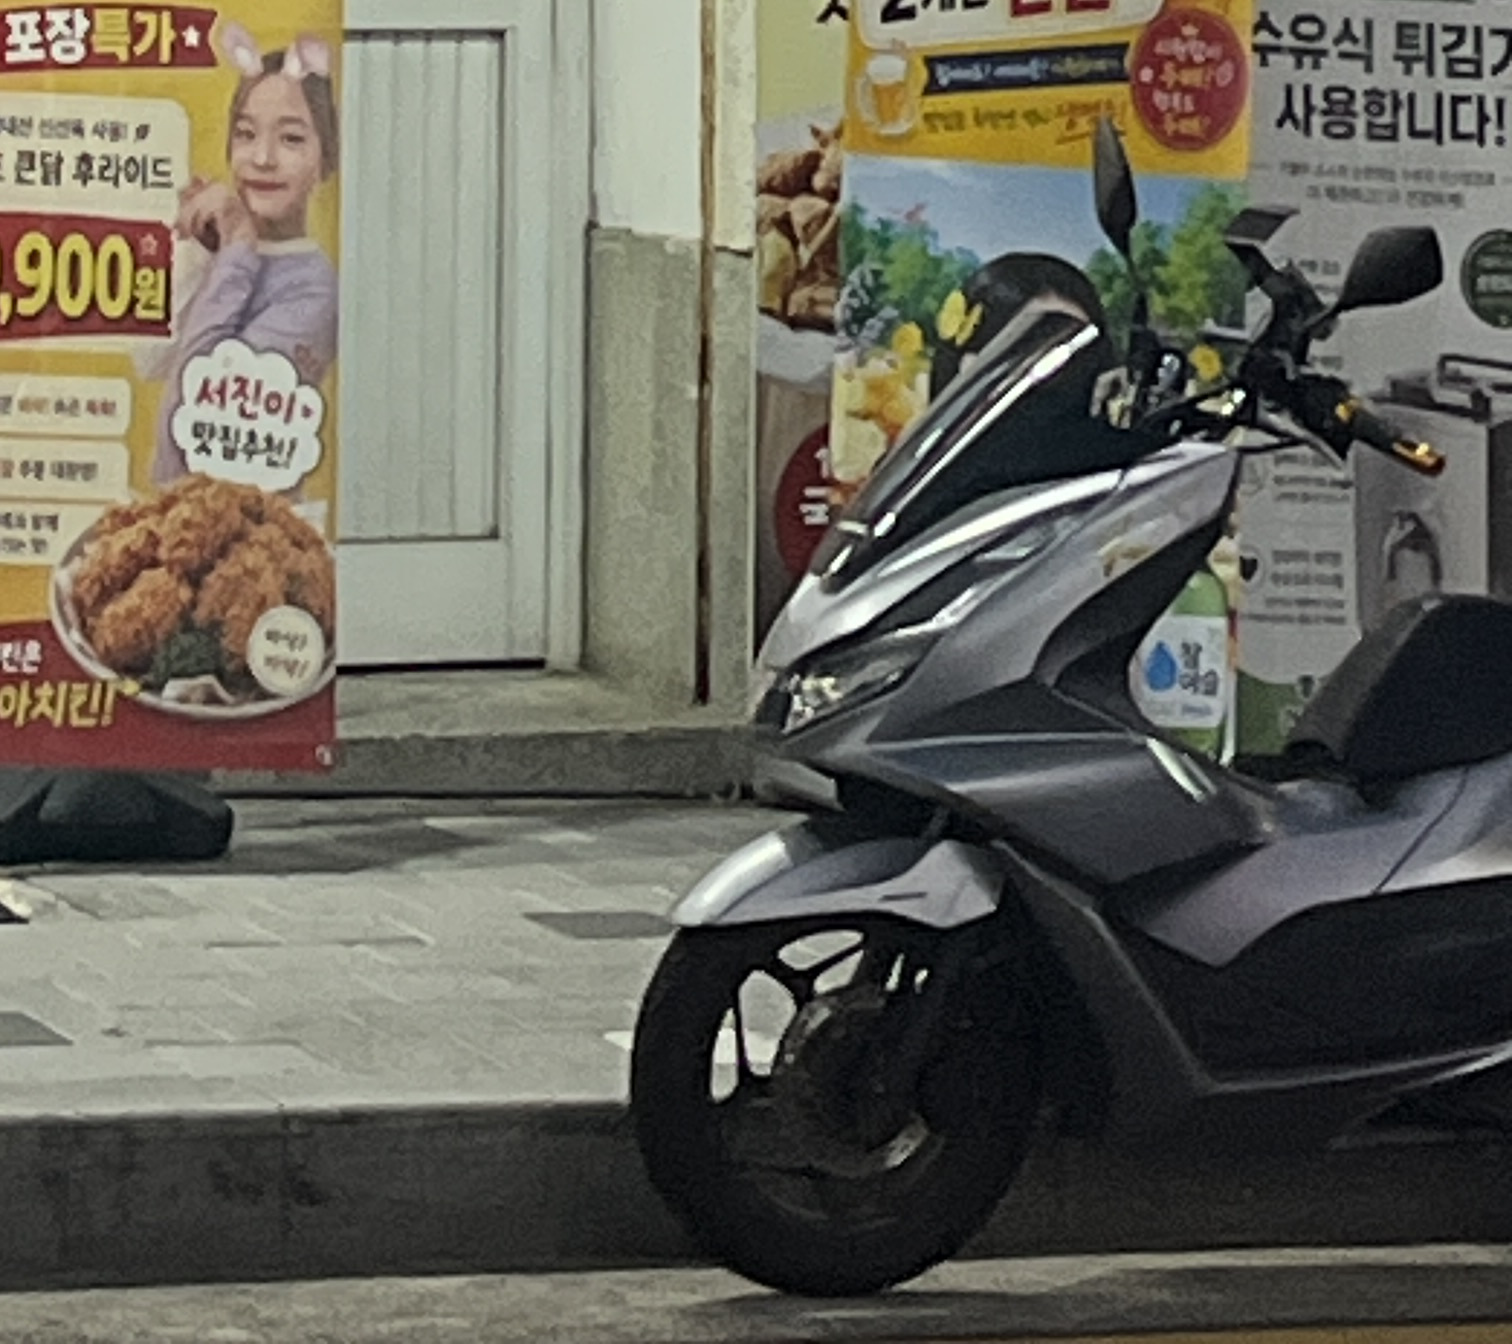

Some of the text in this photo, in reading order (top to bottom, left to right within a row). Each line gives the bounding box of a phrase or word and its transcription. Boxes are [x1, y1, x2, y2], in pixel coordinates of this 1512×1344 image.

[1274, 83, 1506, 149] 사용합니다!
[71, 149, 175, 191] 후라이드
[195, 376, 296, 424] 서진이
